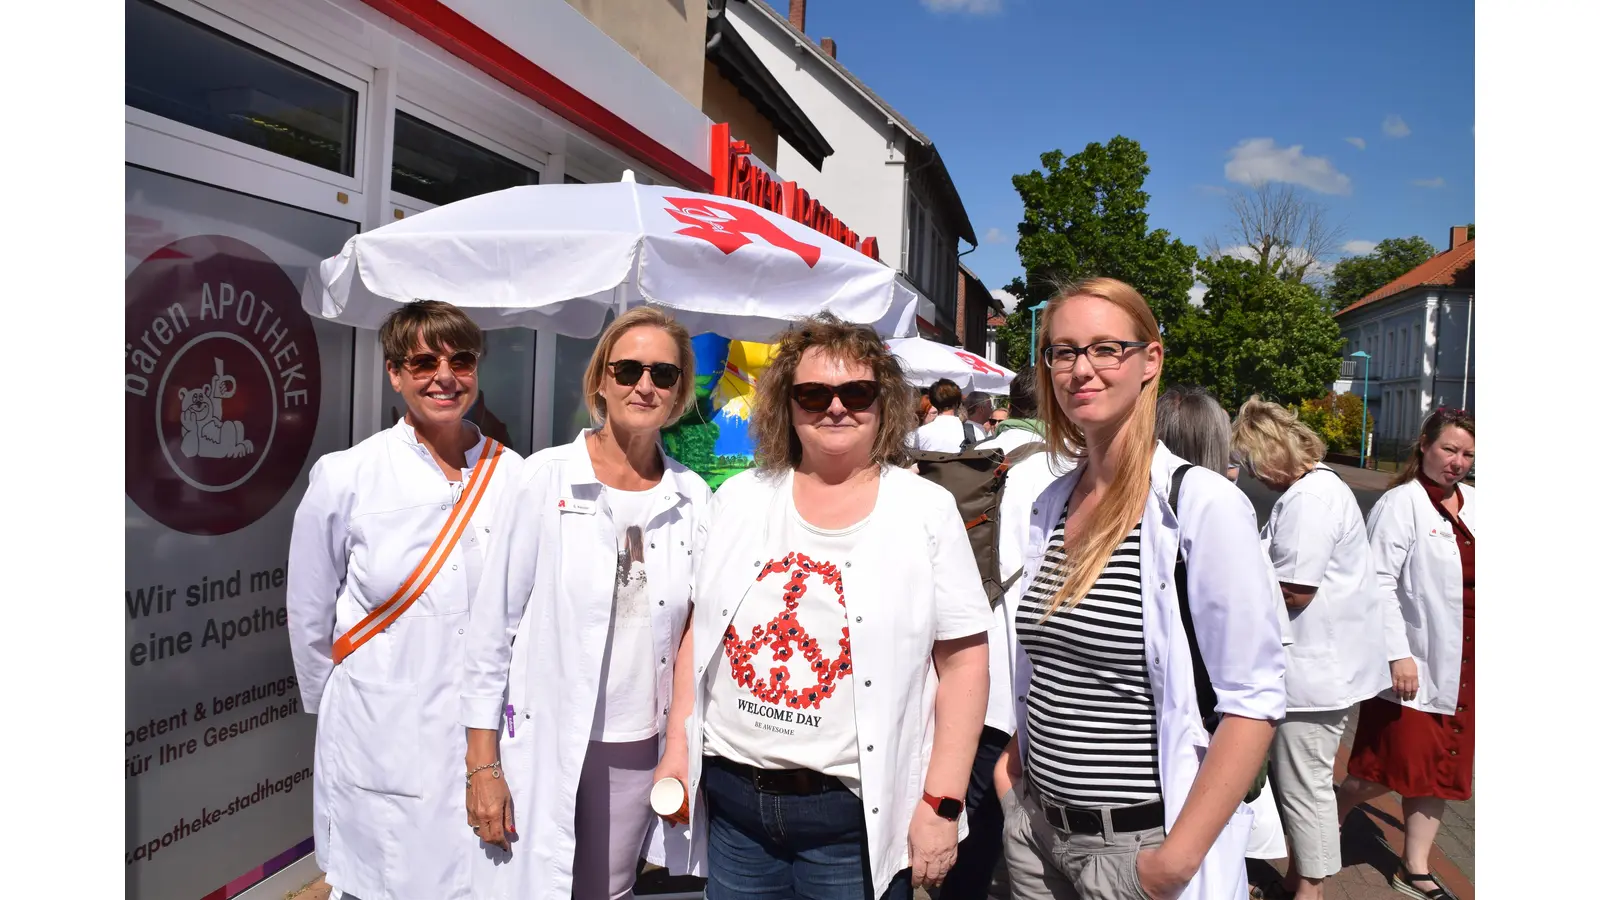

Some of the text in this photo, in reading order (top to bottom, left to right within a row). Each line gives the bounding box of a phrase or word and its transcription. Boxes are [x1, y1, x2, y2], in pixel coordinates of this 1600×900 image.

[200, 282, 308, 408] APOTHEKE
[125, 584, 177, 619] Wir
[185, 569, 241, 607] sind
[129, 605, 288, 667] eine Apothe
[159, 738, 197, 766] Ihre
[203, 697, 298, 747] Gesundheit
[193, 702, 207, 722] &
[737, 698, 822, 728] WELCOME DAY
[754, 720, 795, 736] BE AWESOME
